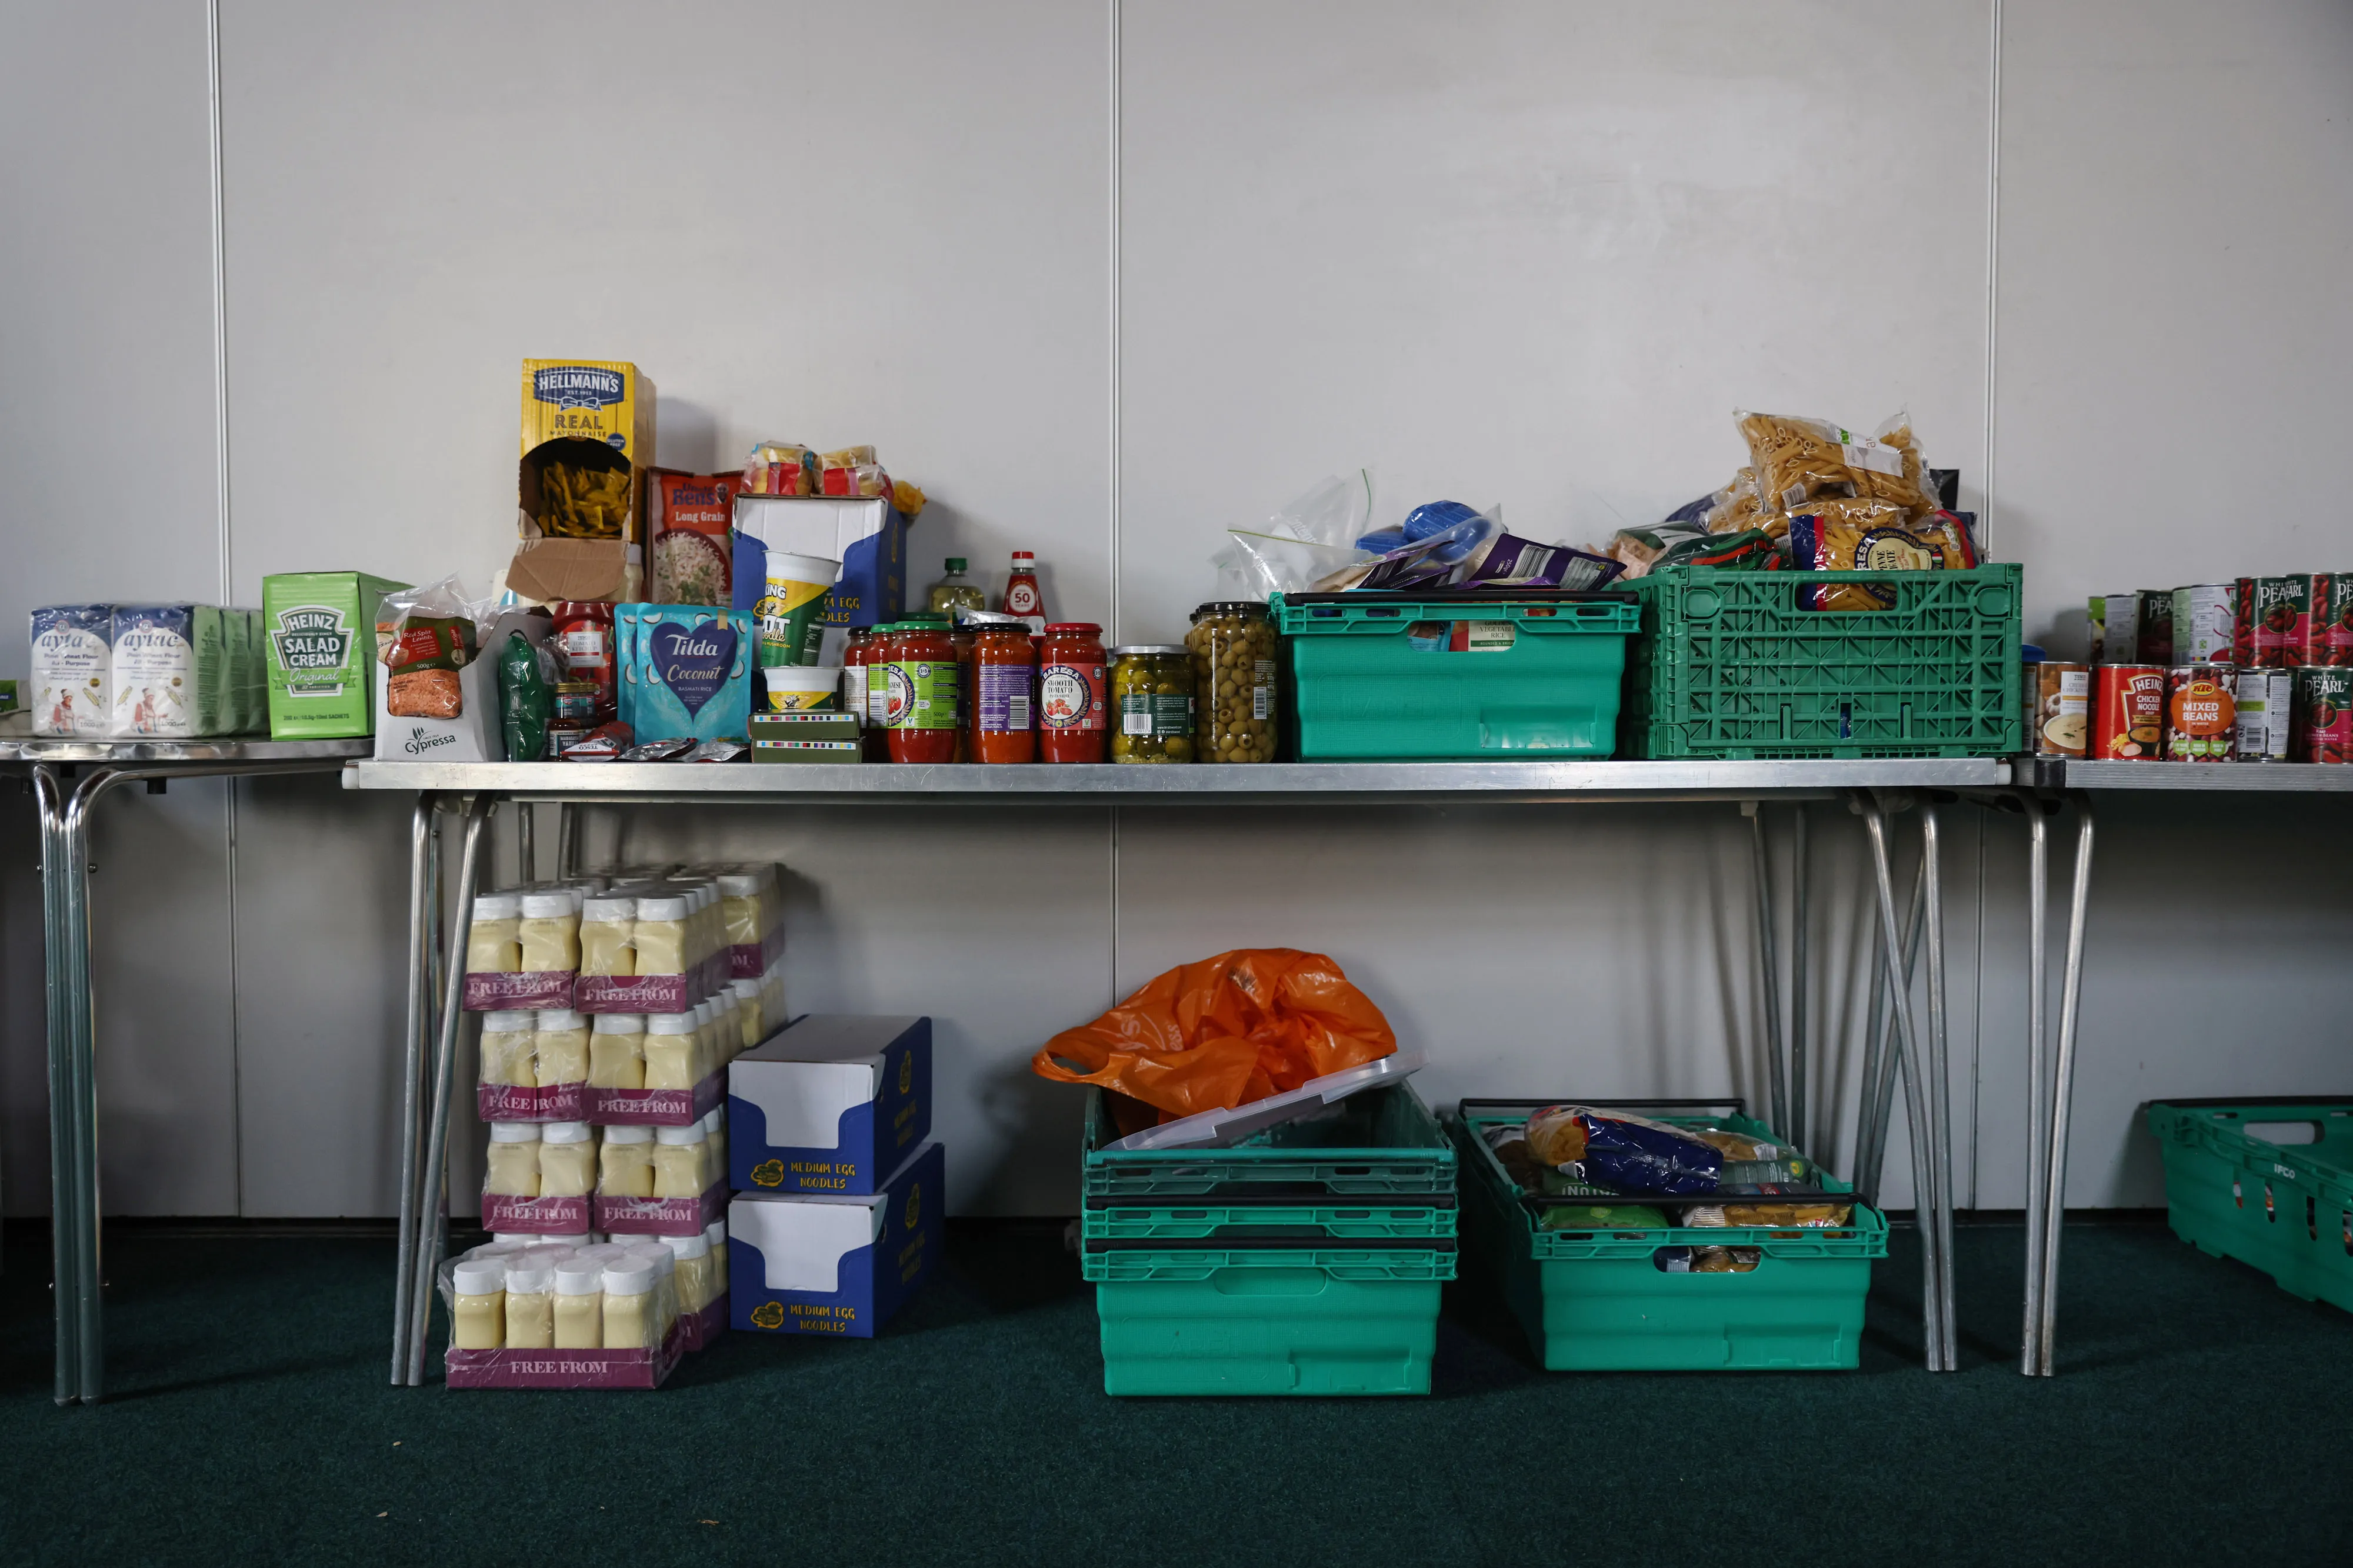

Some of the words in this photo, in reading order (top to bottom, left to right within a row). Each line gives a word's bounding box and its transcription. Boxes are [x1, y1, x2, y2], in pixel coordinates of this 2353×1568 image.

[539, 374, 619, 393] HELLMANN'S
[555, 415, 604, 429] REAL
[675, 511, 699, 523] Long
[701, 511, 725, 522] Grain
[839, 597, 860, 609] EGG
[1015, 593, 1030, 603] 50
[287, 614, 335, 631] HEINZ
[285, 637, 341, 653] SALAD
[665, 634, 718, 656] Tilda
[289, 653, 337, 666] CREAM
[289, 666, 341, 685] Original
[667, 664, 725, 682] Coconut
[1043, 666, 1080, 680] BARESA
[2135, 678, 2163, 692] HEINZ
[2192, 684, 2213, 692] KTC
[2305, 680, 2346, 701] PEARL
[2183, 702, 2219, 711] MIXED
[2183, 712, 2219, 721] BEANS
[405, 735, 456, 755] Cypressa
[469, 982, 512, 995] FREE
[516, 980, 561, 994] FROM
[585, 989, 627, 1000] FREE
[631, 988, 676, 1000] FROM
[488, 1096, 530, 1110] FREE
[533, 1094, 573, 1111] FROM
[598, 1099, 639, 1113] FREE
[642, 1100, 687, 1114] FROM
[791, 1162, 831, 1174] MEDIUM
[836, 1163, 856, 1176] EGG
[2274, 1163, 2295, 1179] IFCO
[800, 1177, 846, 1189] NOODLES
[493, 1206, 534, 1219] FREE
[535, 1207, 578, 1220] FROM
[604, 1207, 646, 1219] FREE
[649, 1207, 692, 1222] FROM
[790, 1305, 830, 1317] MEDIUM
[835, 1306, 855, 1320] EGG
[800, 1320, 845, 1332] NOODLES
[511, 1360, 556, 1374] FREE
[559, 1360, 608, 1374] FROM
